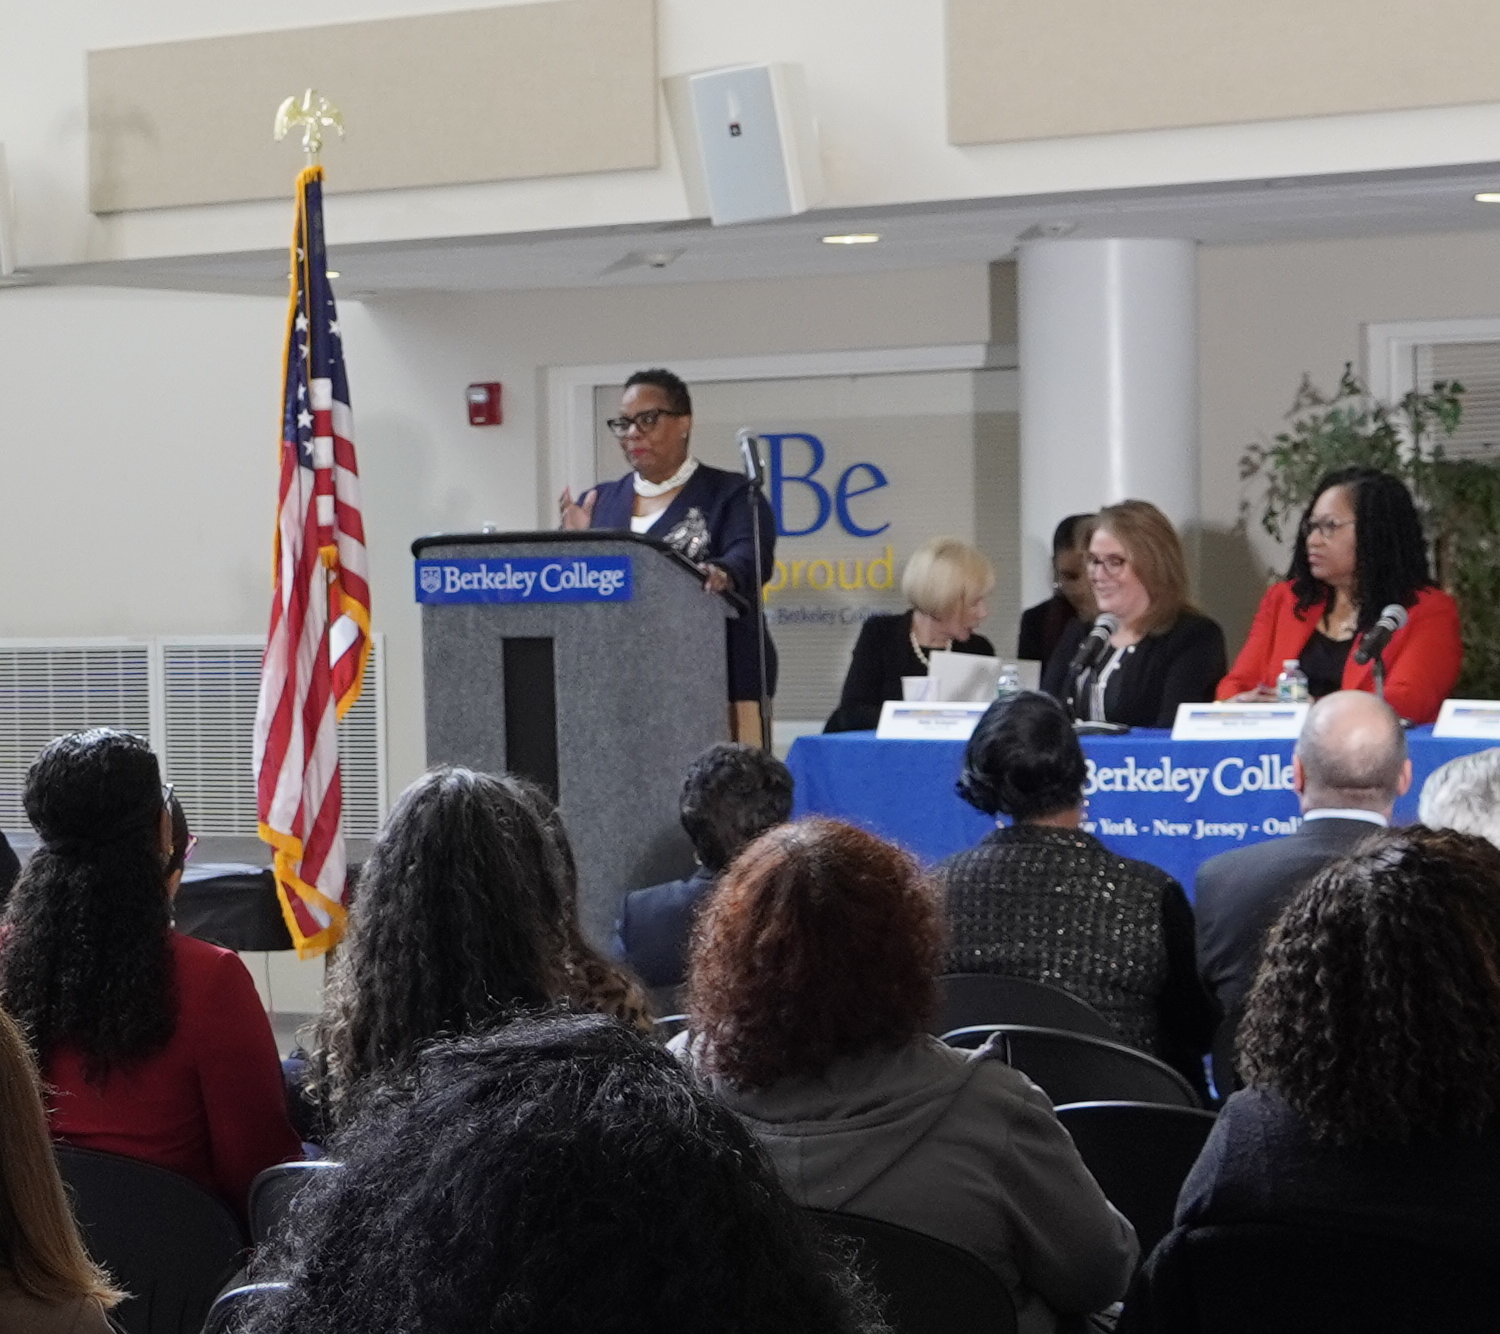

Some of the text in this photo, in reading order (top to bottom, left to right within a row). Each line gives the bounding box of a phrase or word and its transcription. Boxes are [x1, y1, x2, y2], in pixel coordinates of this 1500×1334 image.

[758, 433, 891, 537] Be
[443, 561, 625, 597] Berkeley College
[762, 546, 894, 601] proud
[1082, 754, 1296, 803] Berkeley Colle
[1099, 818, 1139, 836] York
[1152, 819, 1192, 836] New
[1193, 819, 1248, 840] Jersey
[1262, 816, 1304, 836] Onl
